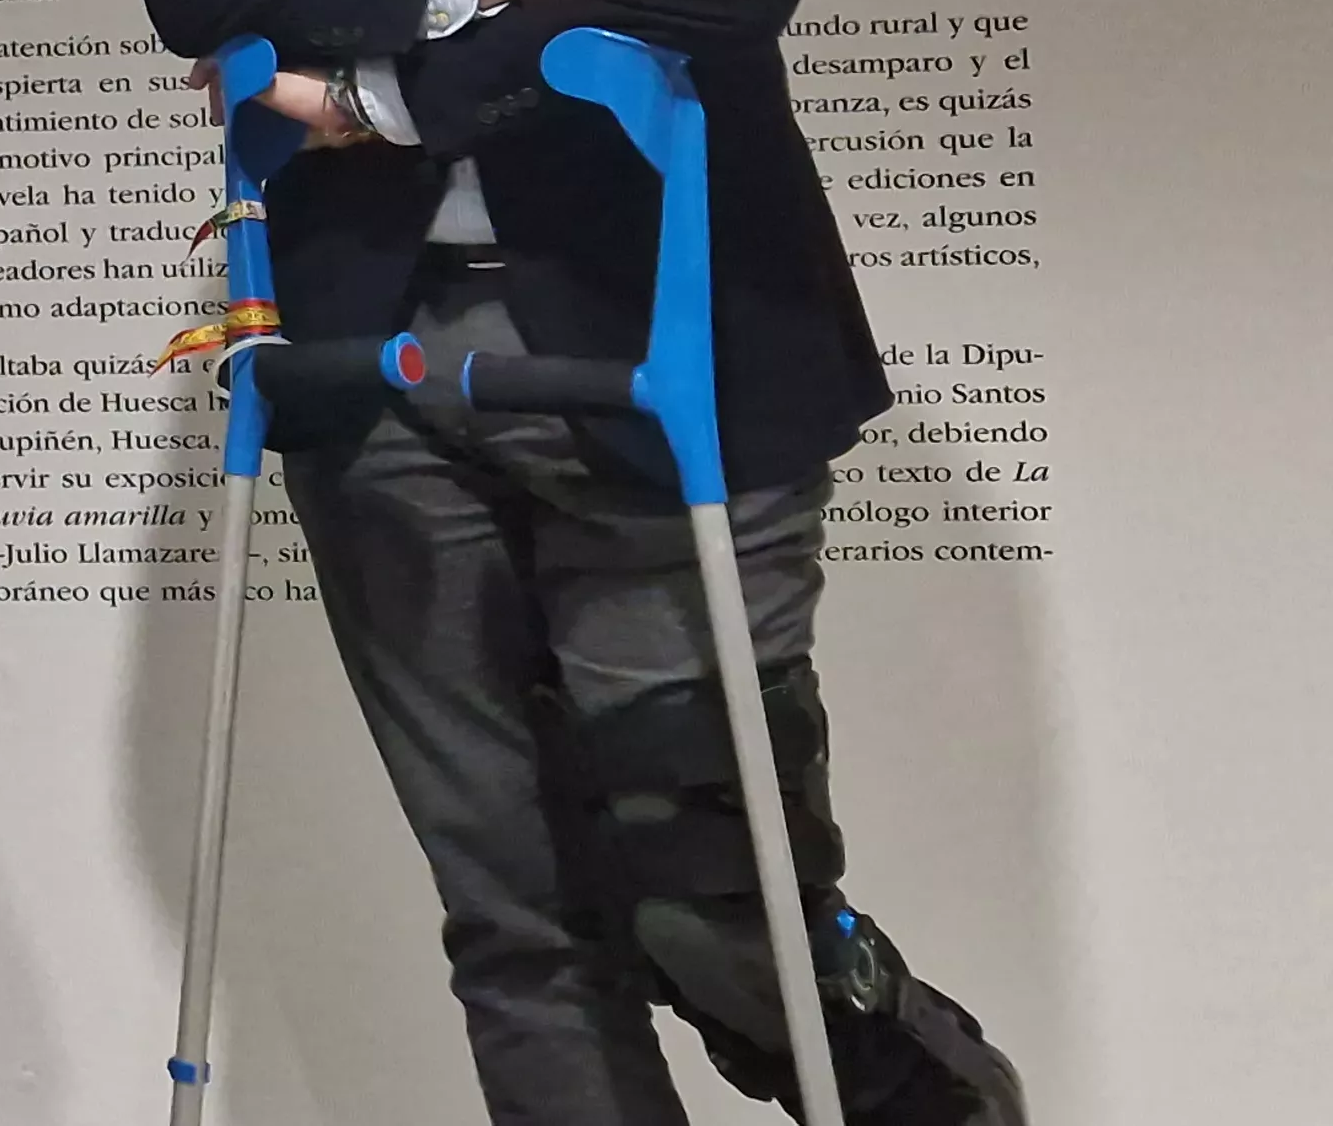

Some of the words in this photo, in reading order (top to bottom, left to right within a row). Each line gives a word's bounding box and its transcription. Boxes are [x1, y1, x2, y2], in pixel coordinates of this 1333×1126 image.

[870, 12, 937, 34] rural
[948, 18, 964, 39] y
[974, 16, 1028, 38] que
[99, 78, 131, 92] en
[148, 76, 191, 93] sus
[793, 54, 952, 79] desamparo
[970, 56, 985, 77] y
[1005, 48, 1029, 69] el
[128, 108, 159, 129] de
[899, 96, 929, 111] es
[939, 88, 1031, 116] quizás
[104, 144, 225, 174] principal
[940, 134, 993, 155] que
[1008, 126, 1032, 147] la
[64, 185, 95, 204] ha
[109, 182, 195, 203] tenido
[209, 188, 223, 208] y
[848, 168, 985, 190] ediciones
[1000, 172, 1034, 186] en
[82, 228, 96, 248] y
[853, 213, 908, 230] vez,
[923, 206, 1036, 233] algunos
[104, 259, 153, 279] han
[901, 245, 1039, 268] artísticos,
[51, 295, 228, 324] adaptaciones
[73, 352, 159, 382] quizás
[881, 343, 915, 366] de
[927, 344, 949, 364] la
[963, 344, 1043, 370] Dipu-
[59, 392, 90, 412] de
[101, 393, 198, 413] Huesca
[952, 384, 1045, 403] Santos
[908, 420, 1047, 443] debiendo
[62, 474, 90, 488] su
[879, 465, 951, 482] texto
[966, 461, 1000, 482] de
[1013, 462, 1048, 481] La
[65, 503, 188, 528] amarilla
[198, 511, 212, 531] y
[944, 501, 1051, 521] interior
[78, 541, 222, 566] Llamazare
[935, 544, 1052, 561] contem-
[100, 586, 151, 607] que
[162, 581, 215, 601] más
[286, 580, 317, 601] ha
